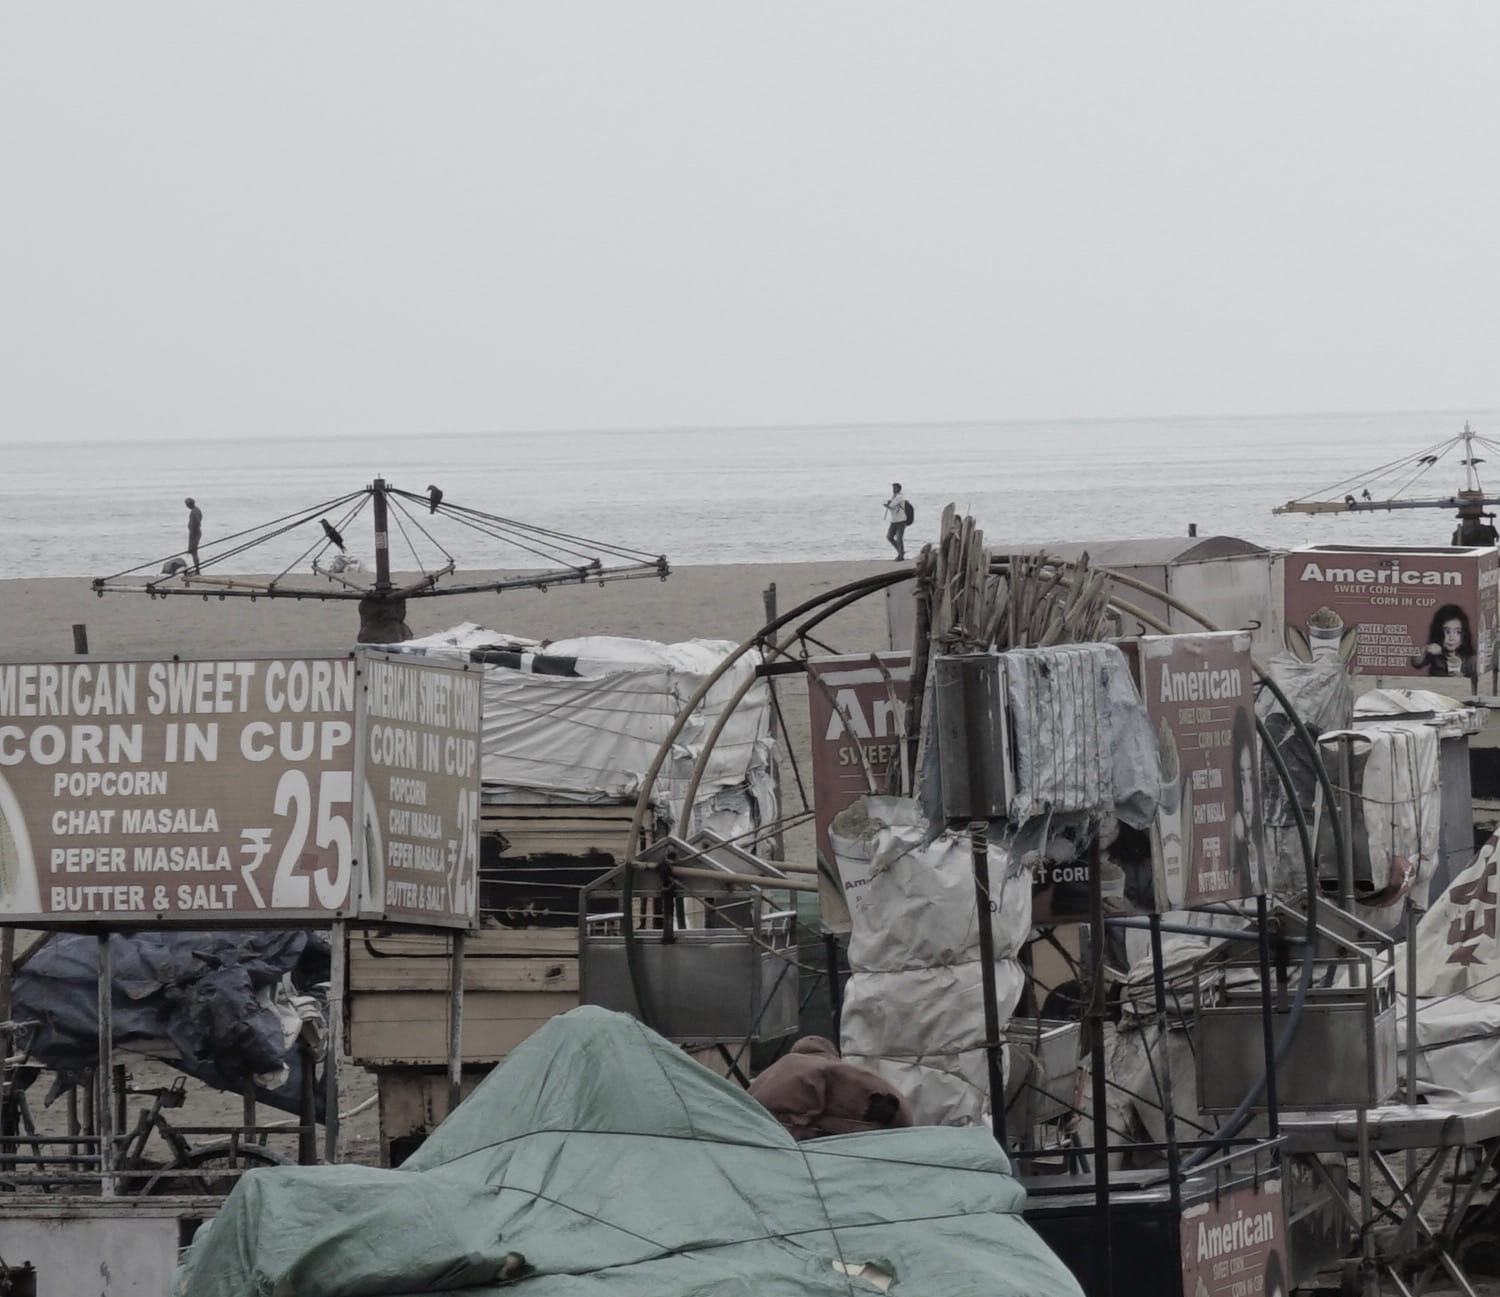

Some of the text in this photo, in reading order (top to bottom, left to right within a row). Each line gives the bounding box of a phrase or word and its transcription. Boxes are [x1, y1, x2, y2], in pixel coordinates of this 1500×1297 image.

[1300, 563, 1463, 586] American
[1334, 584, 1398, 595] SWEET CORN
[1370, 596, 1437, 607] CORN IN CUP
[148, 661, 255, 714] SWEET
[265, 661, 354, 713] CORN
[1160, 661, 1241, 703] American
[367, 661, 479, 733] AMERICAN SWEET CORN
[0, 721, 351, 765] CORN IN CUP
[370, 724, 476, 778] CORN IN CUP
[54, 771, 167, 797] POPCORN
[389, 776, 427, 805] POPCORN
[52, 809, 219, 835] CHAT MASALA
[51, 847, 232, 872] PEPER MASALA
[51, 884, 237, 911] BUTTER & SALT
[1197, 1210, 1274, 1262] American
